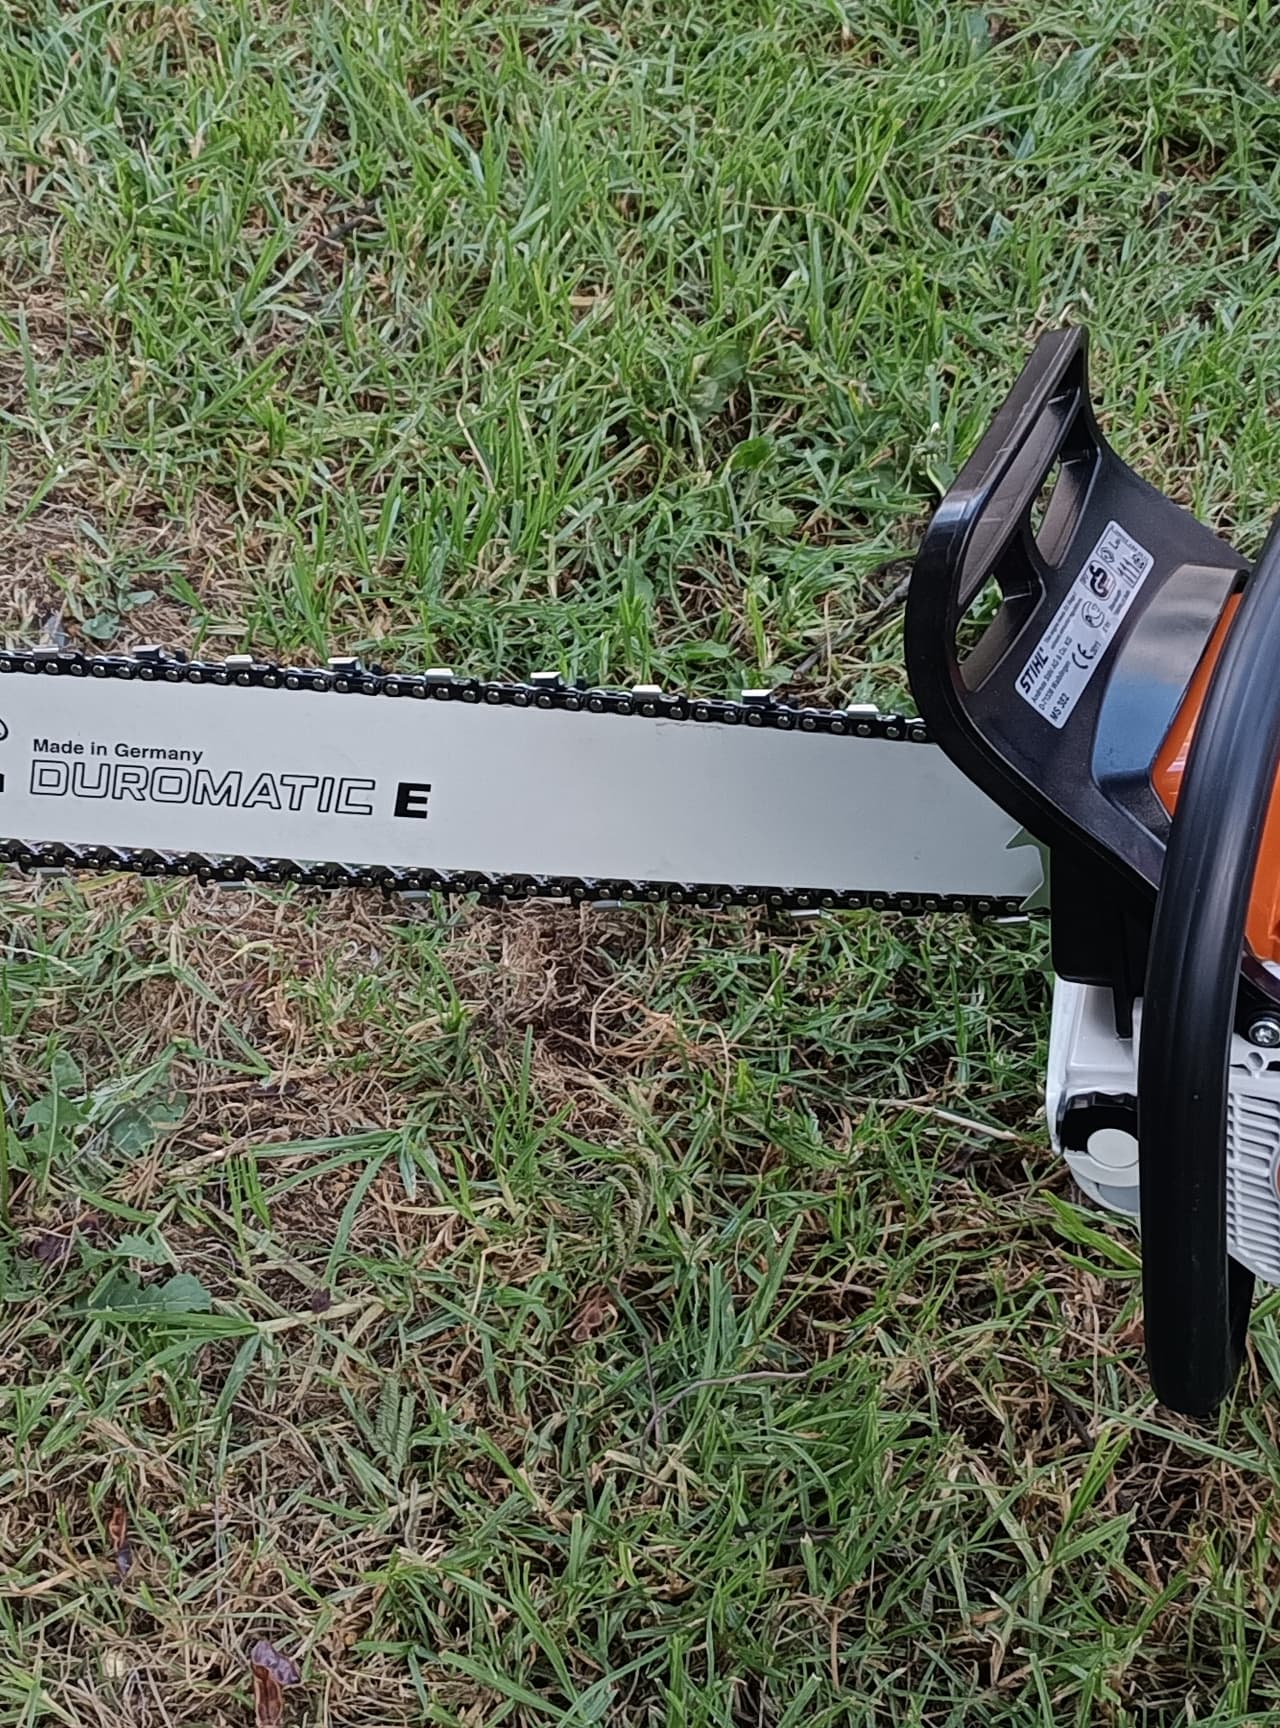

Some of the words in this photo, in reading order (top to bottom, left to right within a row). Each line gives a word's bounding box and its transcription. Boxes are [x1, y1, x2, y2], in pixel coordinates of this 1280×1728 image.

[33, 738, 84, 756] Made
[90, 741, 108, 757] in
[114, 743, 204, 766] Germany
[30, 759, 376, 816] DUROMATIC
[393, 782, 431, 819] E
